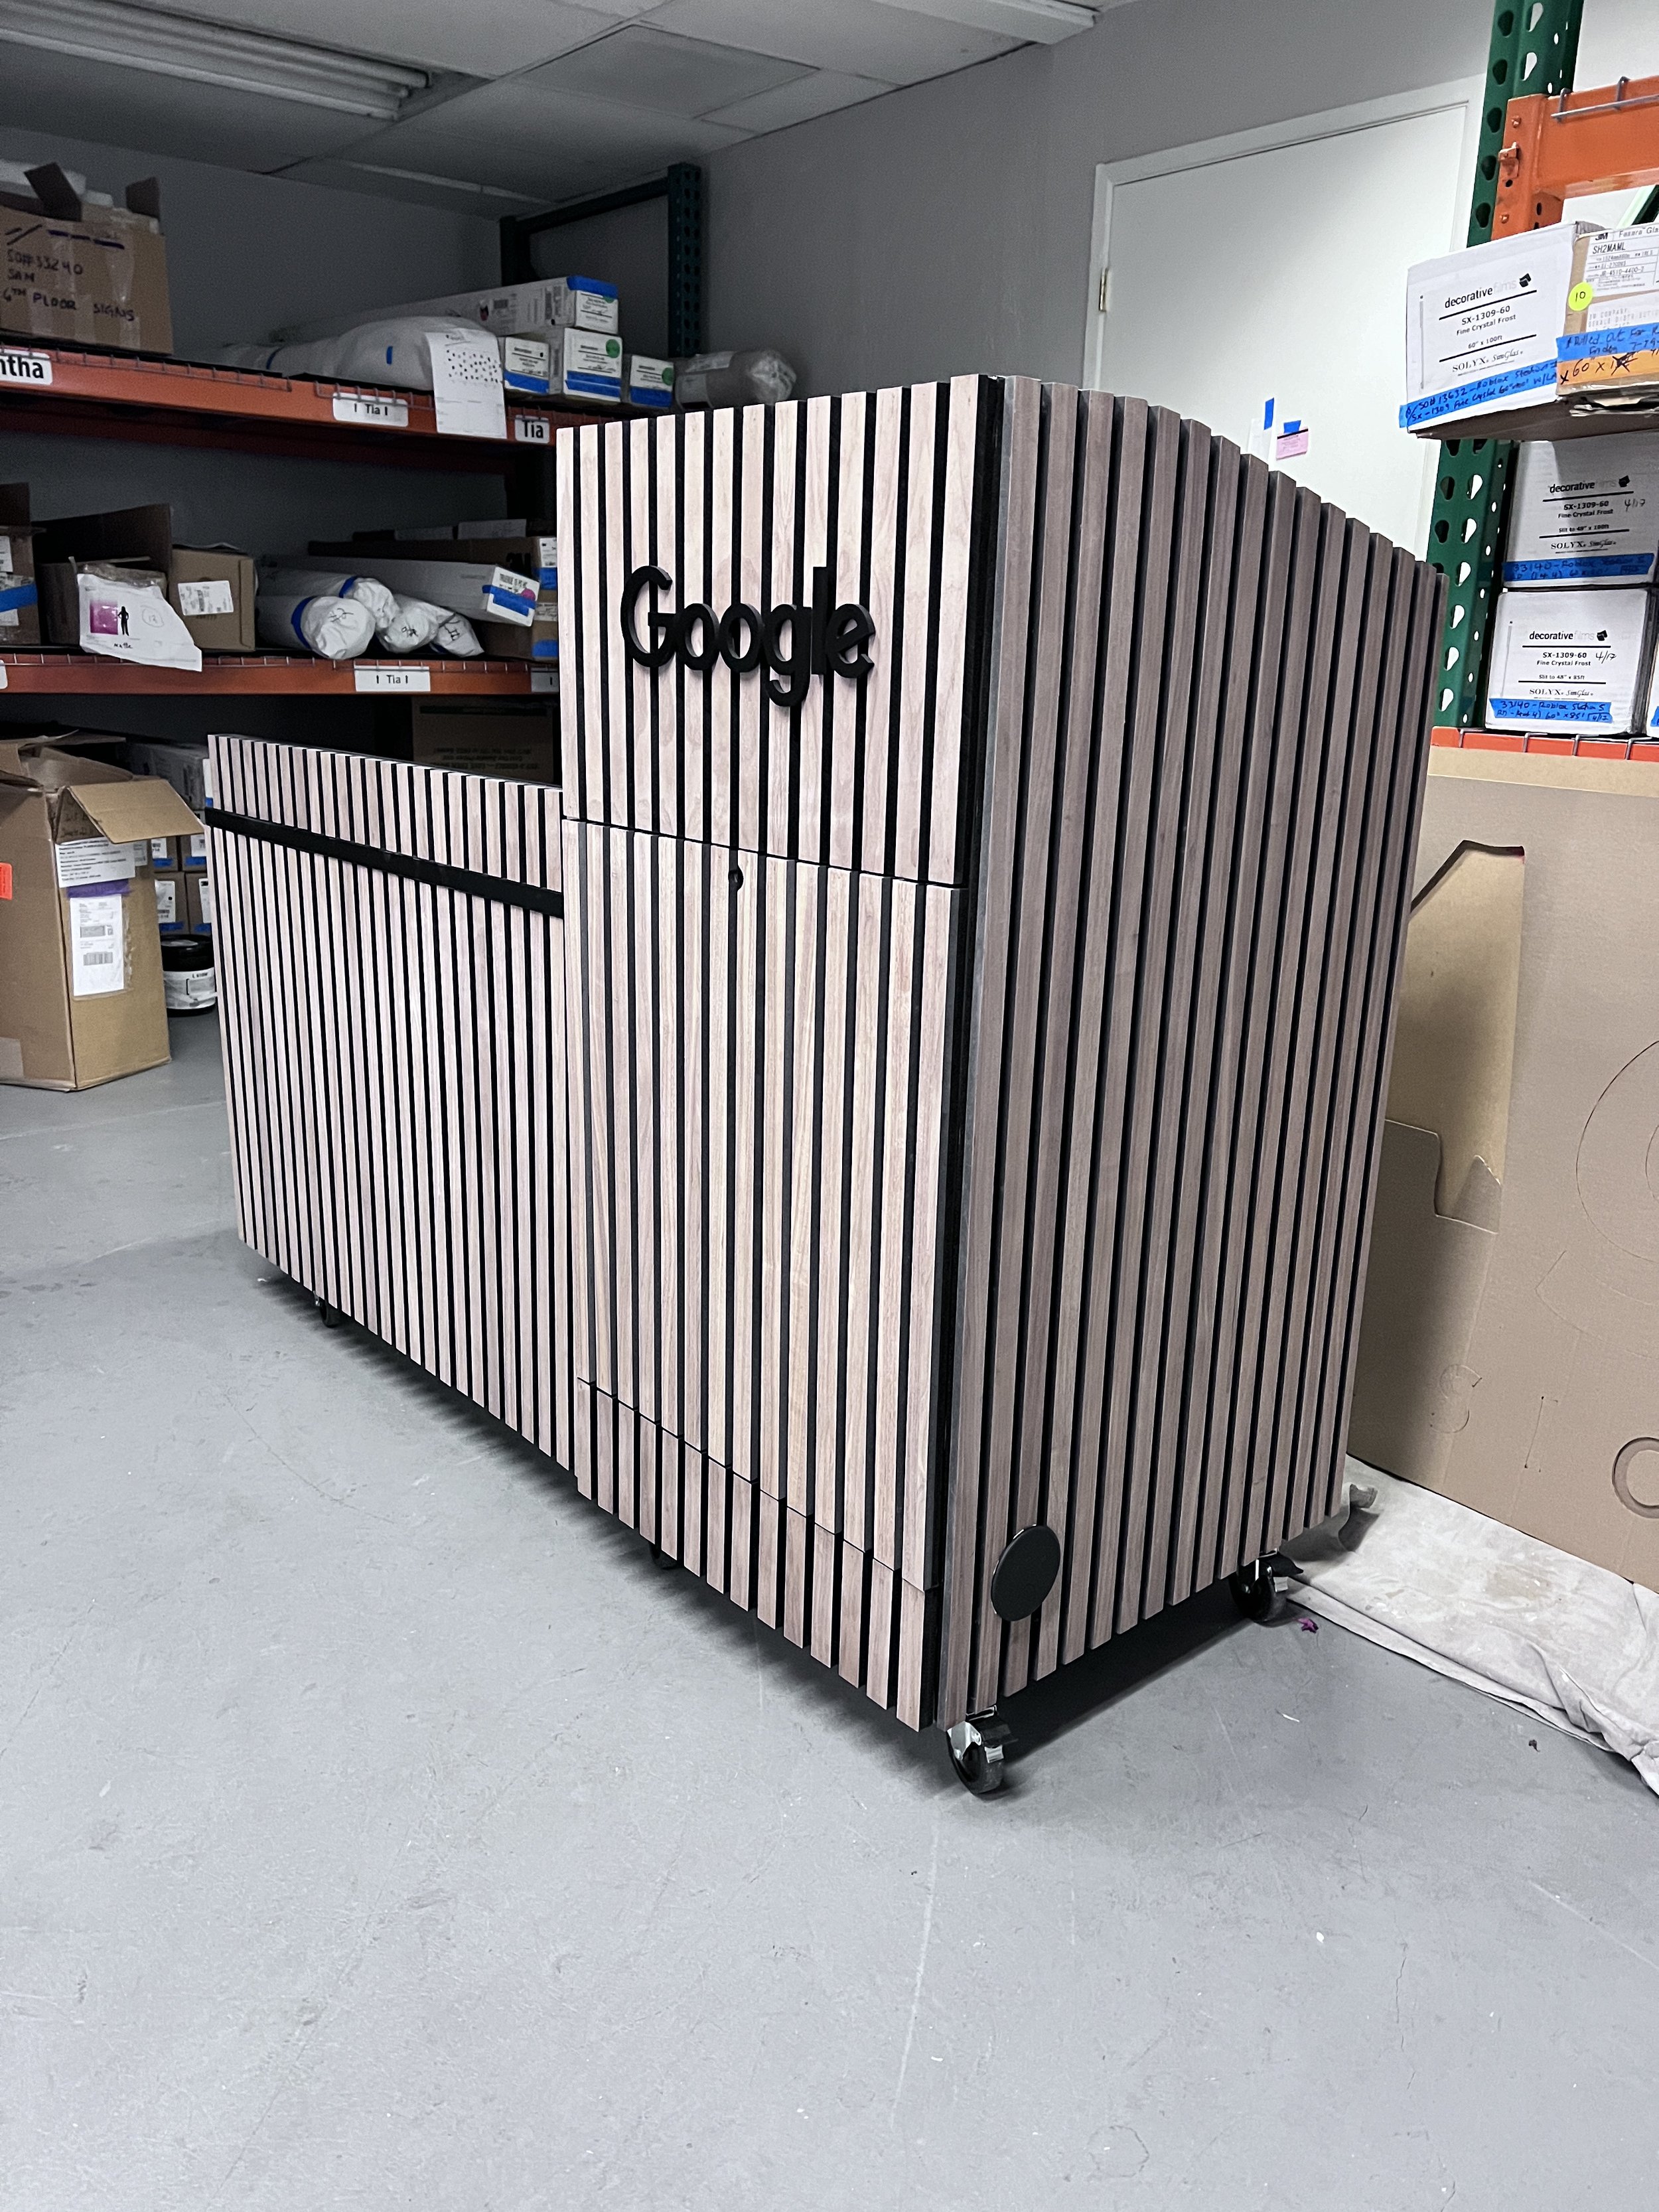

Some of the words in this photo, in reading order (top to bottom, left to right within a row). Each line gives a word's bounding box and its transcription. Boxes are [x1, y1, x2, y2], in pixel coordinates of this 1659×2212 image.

[1593, 242, 1626, 254] SH2MAML
[1576, 291, 1586, 303] 10
[1462, 305, 1510, 326] SX-1309-60
[1457, 327, 1470, 336] Fine
[1472, 320, 1496, 332] Crystal
[1498, 315, 1517, 325] Frost
[1486, 335, 1502, 344] 100ft
[522, 420, 543, 439] Tia
[1550, 482, 1595, 493] decorative
[1563, 500, 1609, 510] SX-1309-60
[1550, 541, 1585, 550] SOLYX
[620, 565, 876, 707] Google
[1529, 630, 1573, 640] decorative
[386, 674, 401, 684] Tia
